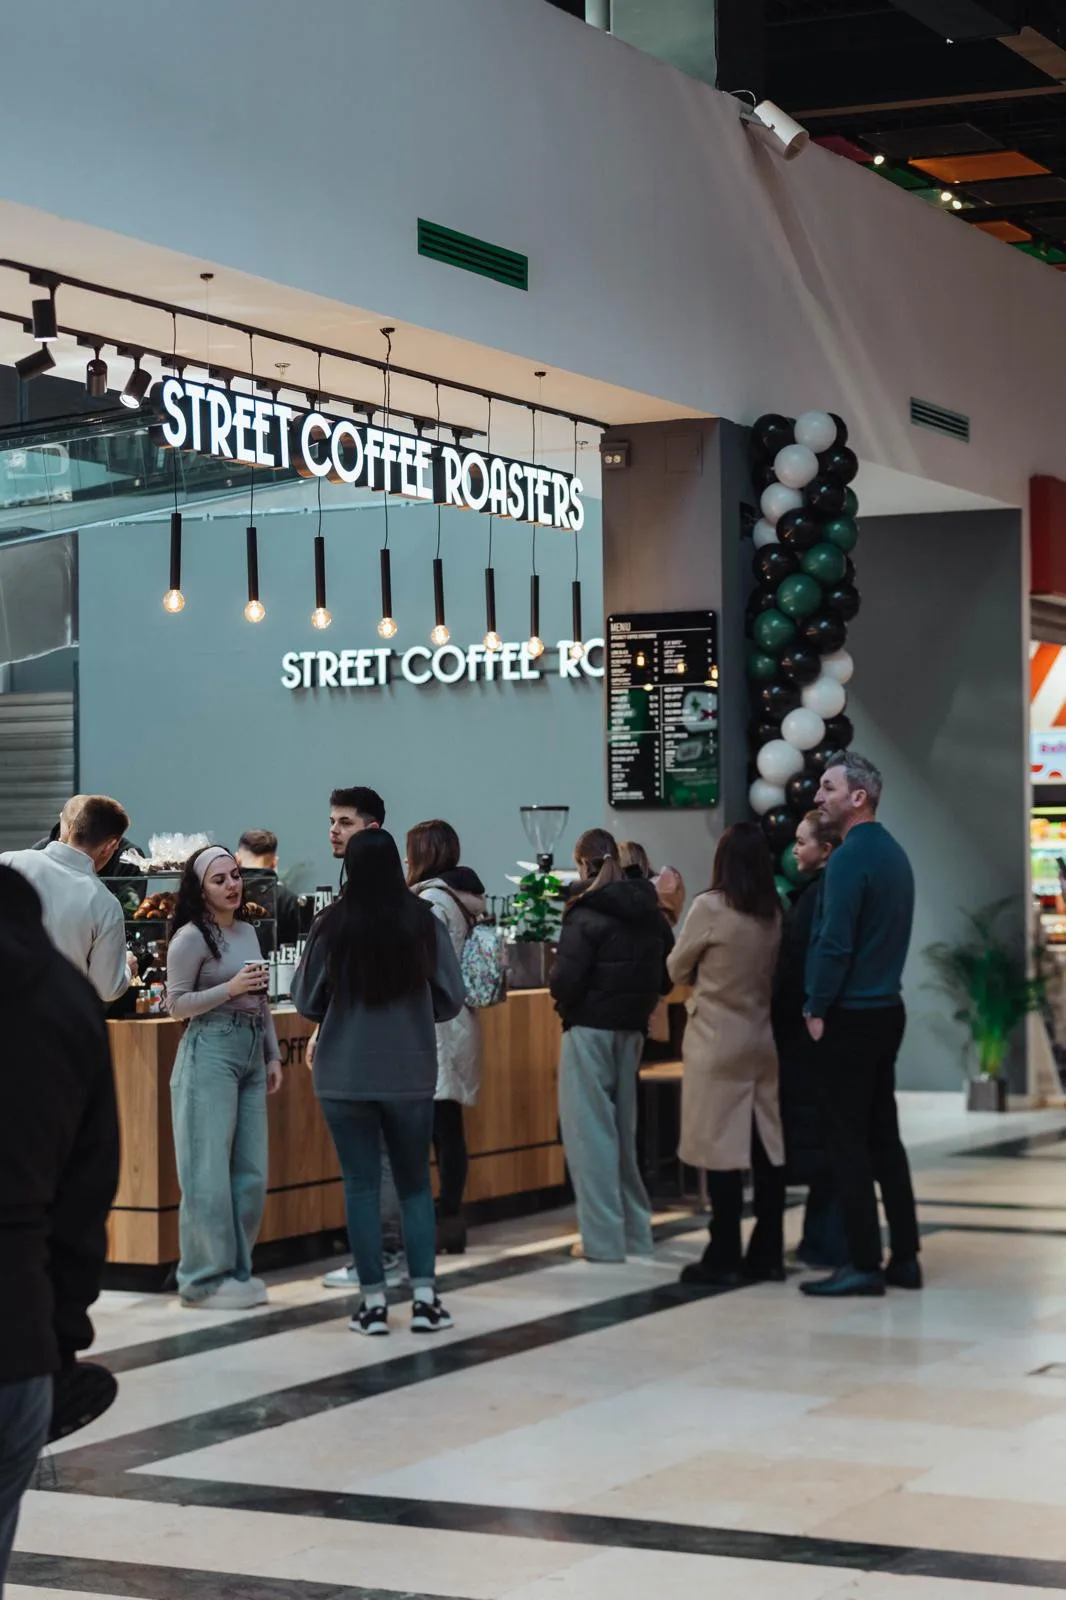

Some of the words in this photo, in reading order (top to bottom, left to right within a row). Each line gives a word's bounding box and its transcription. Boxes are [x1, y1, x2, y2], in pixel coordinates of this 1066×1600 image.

[162, 379, 292, 469] STREET
[301, 413, 433, 500] COFFEE
[442, 448, 585, 532] ROASTERS
[281, 648, 391, 689] STREET
[401, 643, 541, 684] COFFEE
